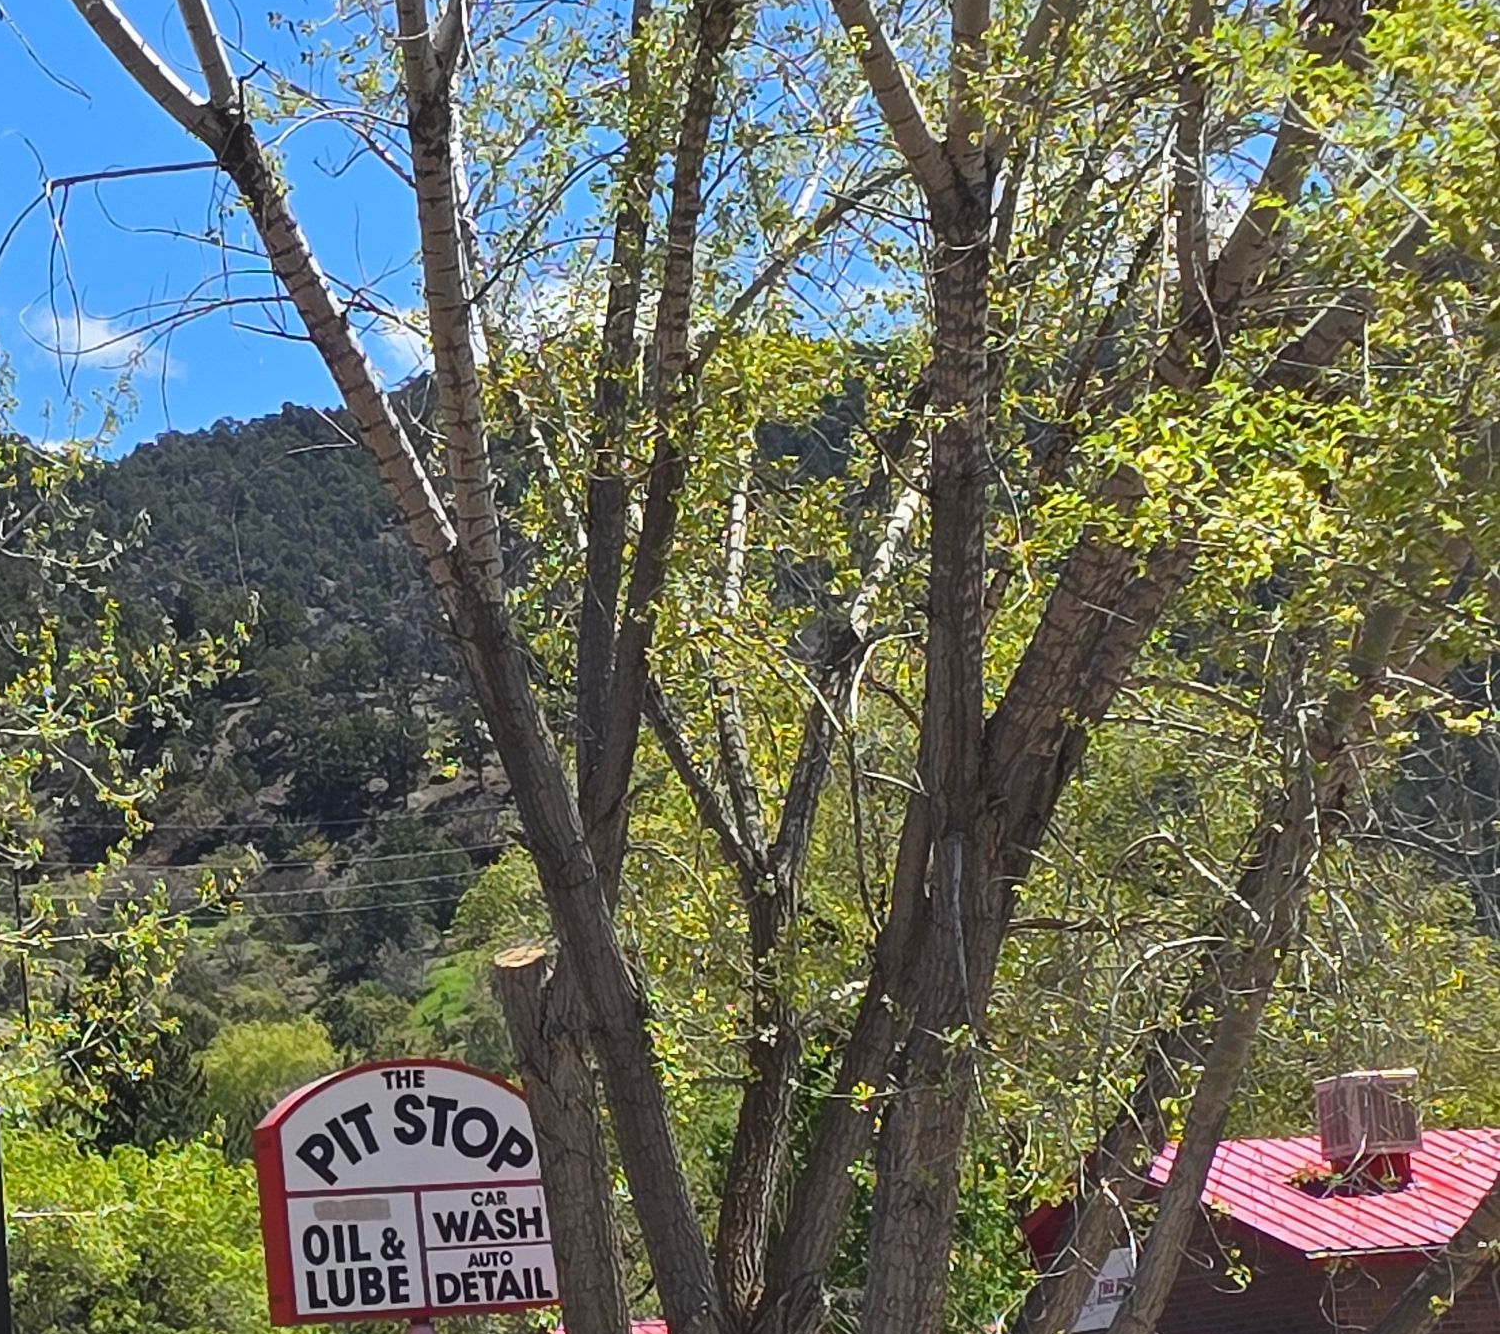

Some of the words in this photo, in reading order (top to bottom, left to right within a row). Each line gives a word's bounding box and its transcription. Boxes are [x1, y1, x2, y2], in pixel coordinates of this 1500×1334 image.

[381, 1069, 426, 1090] THE
[295, 1102, 380, 1187] PIT
[393, 1093, 534, 1173] STOP
[470, 1191, 508, 1207] CAR
[432, 1207, 544, 1244] WASH
[302, 1224, 372, 1266] OIL
[379, 1226, 407, 1261] &
[467, 1250, 514, 1269] AUTO
[305, 1266, 411, 1310] LUBE
[435, 1266, 554, 1305] DETAIL
